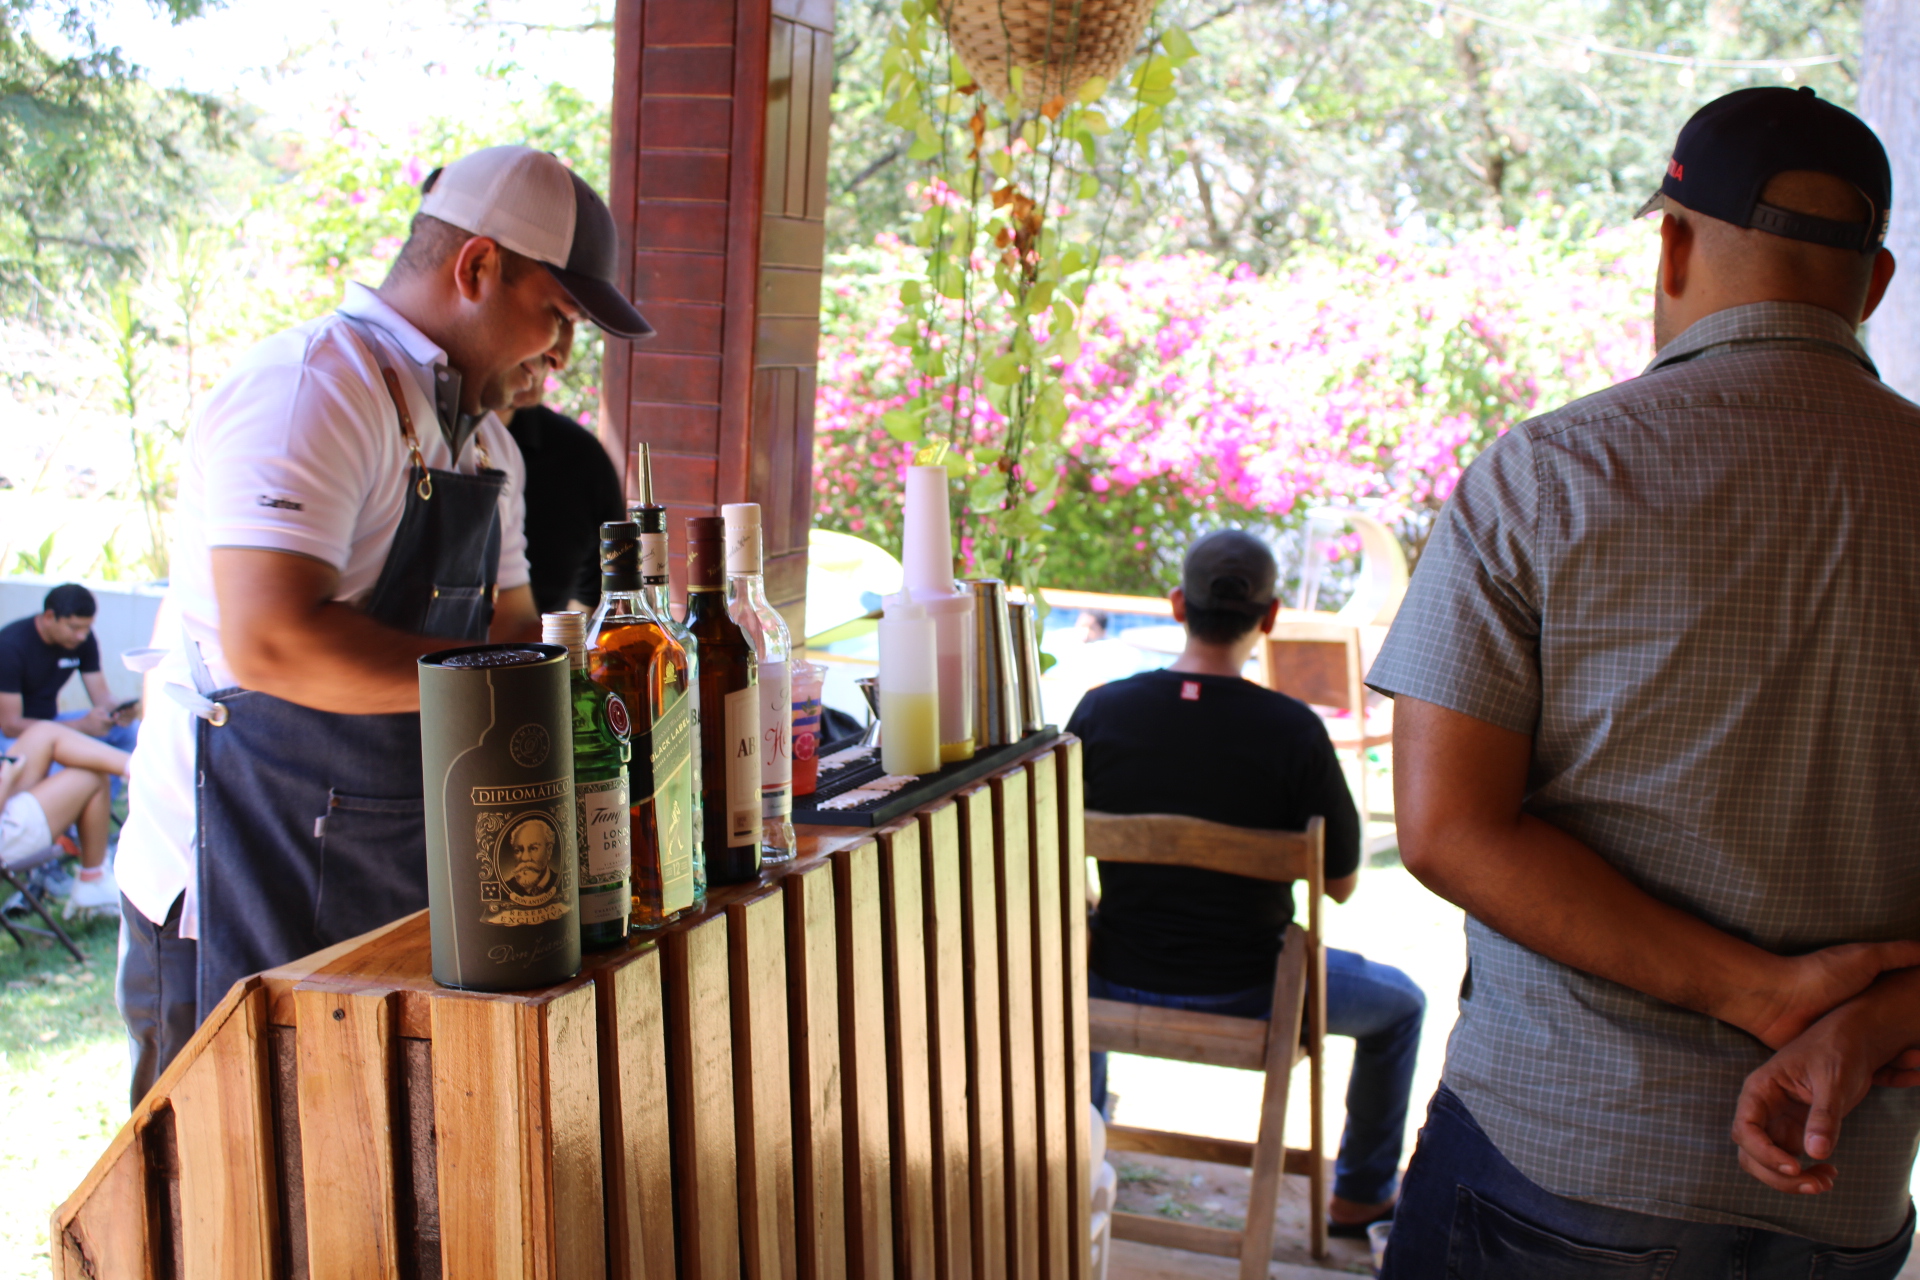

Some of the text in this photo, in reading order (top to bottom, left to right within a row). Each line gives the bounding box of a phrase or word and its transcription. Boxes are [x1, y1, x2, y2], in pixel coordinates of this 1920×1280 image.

[650, 717, 690, 763] BLACK LABEL
[479, 780, 570, 803] DIPLOMÁTICO
[672, 861, 681, 877] 12
[500, 908, 563, 925] EXCLUSIVA
[510, 904, 556, 917] RESERVA
